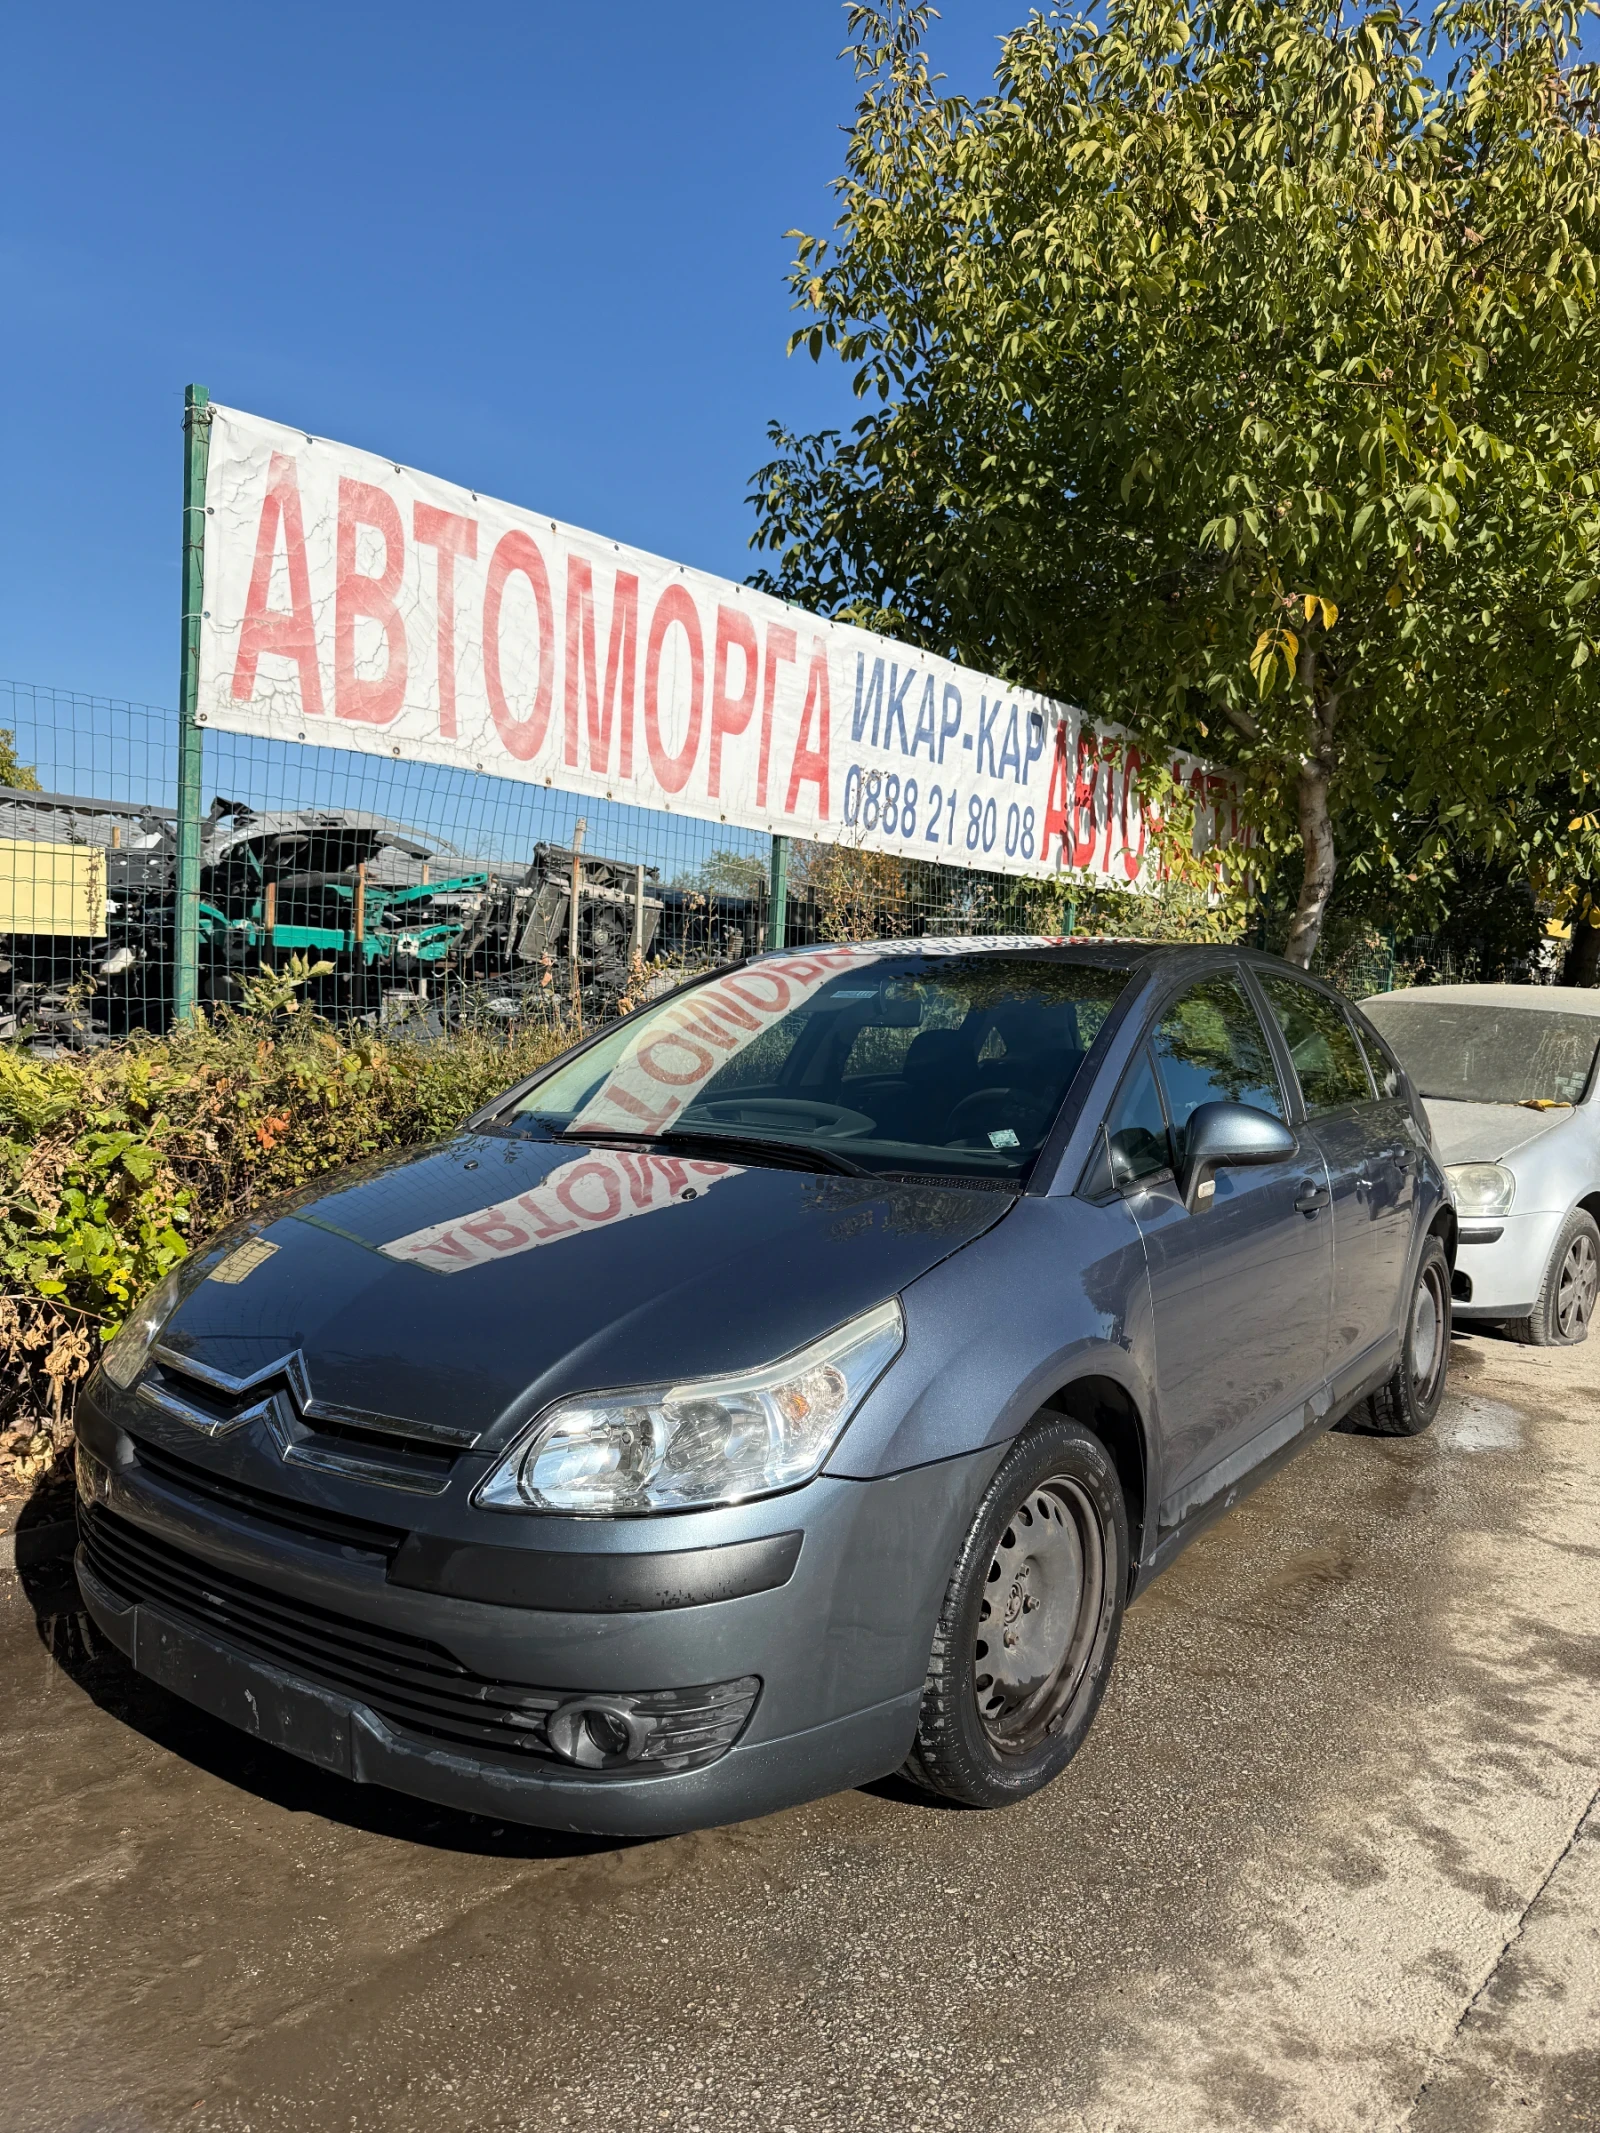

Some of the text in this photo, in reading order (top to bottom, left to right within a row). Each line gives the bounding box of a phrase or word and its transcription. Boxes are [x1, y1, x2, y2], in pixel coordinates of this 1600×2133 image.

[231, 450, 831, 821] АВТОМОРГА
[851, 651, 1045, 786] ИКАР-КАР
[843, 763, 1036, 860] 0888 21 80 08
